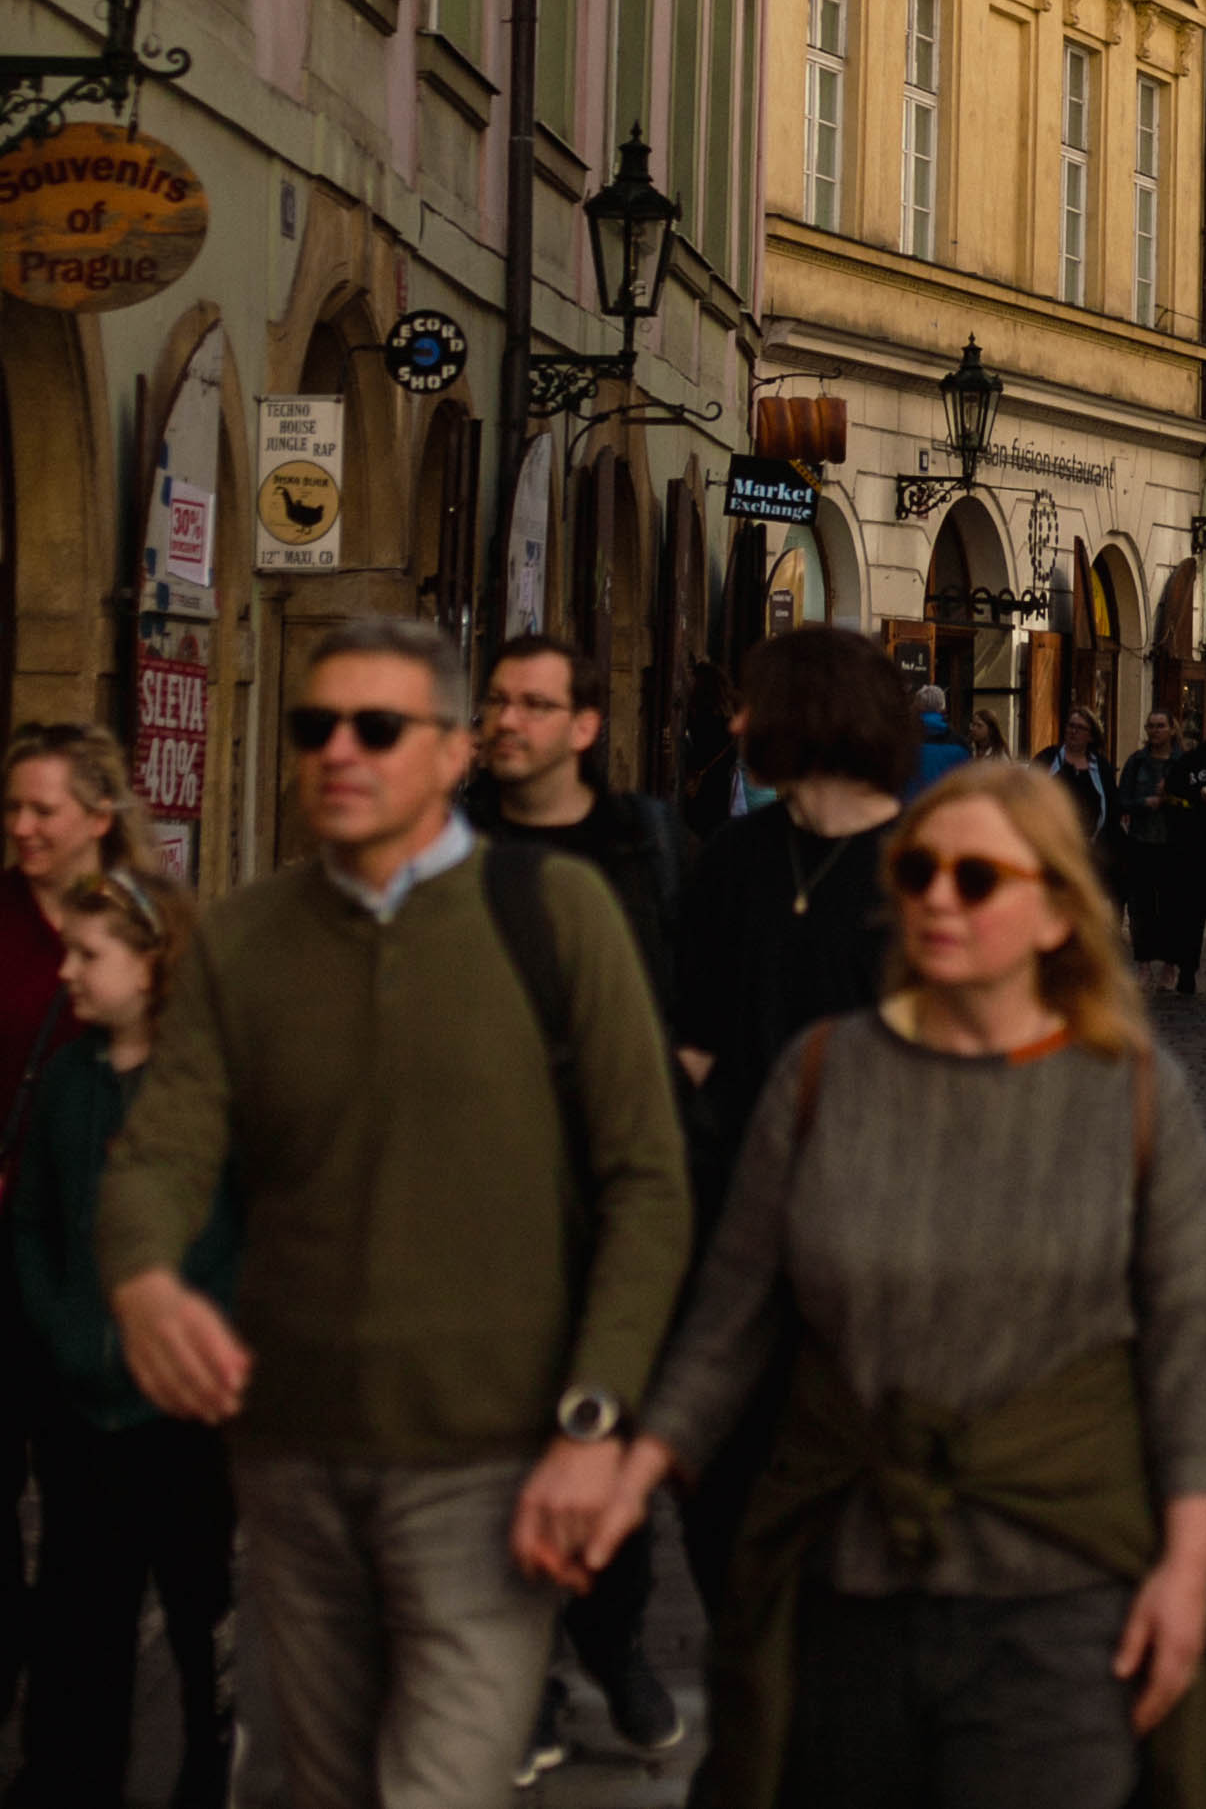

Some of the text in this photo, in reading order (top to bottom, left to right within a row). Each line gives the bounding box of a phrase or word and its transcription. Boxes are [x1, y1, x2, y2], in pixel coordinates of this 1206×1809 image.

[0, 155, 188, 204] Souvenirs
[68, 200, 105, 233] of
[19, 250, 158, 290] Prague
[392, 318, 465, 353] RECORD
[397, 364, 457, 390] SHOP
[266, 403, 310, 417] TECHNO
[279, 420, 316, 434] HOUSE
[266, 437, 336, 457] JUNGLE RAP
[1012, 438, 1050, 475] fusion
[1053, 454, 1116, 489] restaurant
[731, 477, 814, 504] Market
[174, 507, 203, 540] 30%
[729, 496, 813, 521] Exchange
[319, 550, 334, 565] CD
[141, 669, 204, 732] SLEVA
